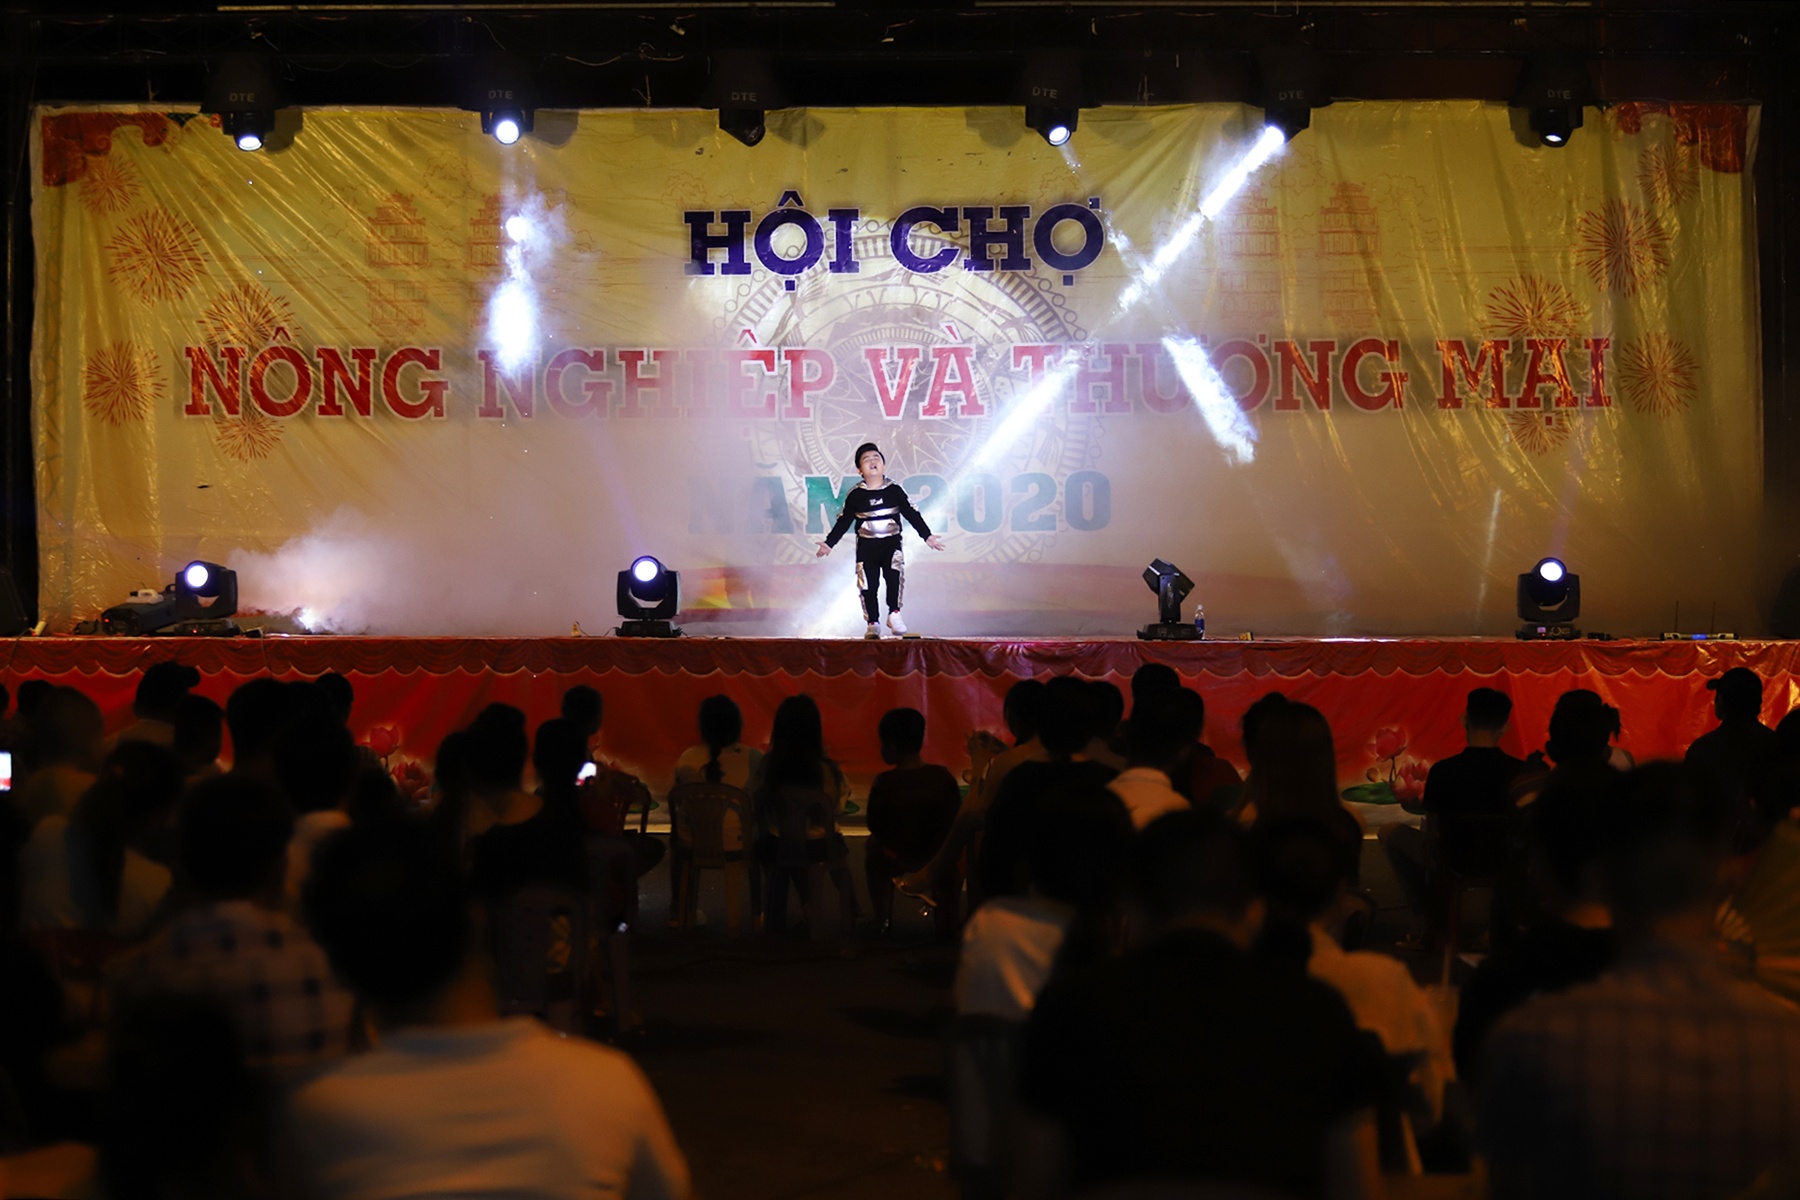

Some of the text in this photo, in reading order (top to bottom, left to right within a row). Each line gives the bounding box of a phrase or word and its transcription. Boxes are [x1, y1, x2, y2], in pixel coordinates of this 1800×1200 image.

[229, 92, 255, 102] DTE
[488, 89, 513, 100] DTE
[731, 91, 757, 102] DTE
[1032, 86, 1058, 99] DTE
[1278, 90, 1304, 101] DTE
[1547, 89, 1572, 100] DTE
[684, 190, 1103, 291] HỘI CHỢ
[184, 327, 448, 418] NÔNG
[864, 322, 985, 418] VÀ
[1436, 337, 1612, 426] MẠI
[901, 470, 1112, 533] 2020
